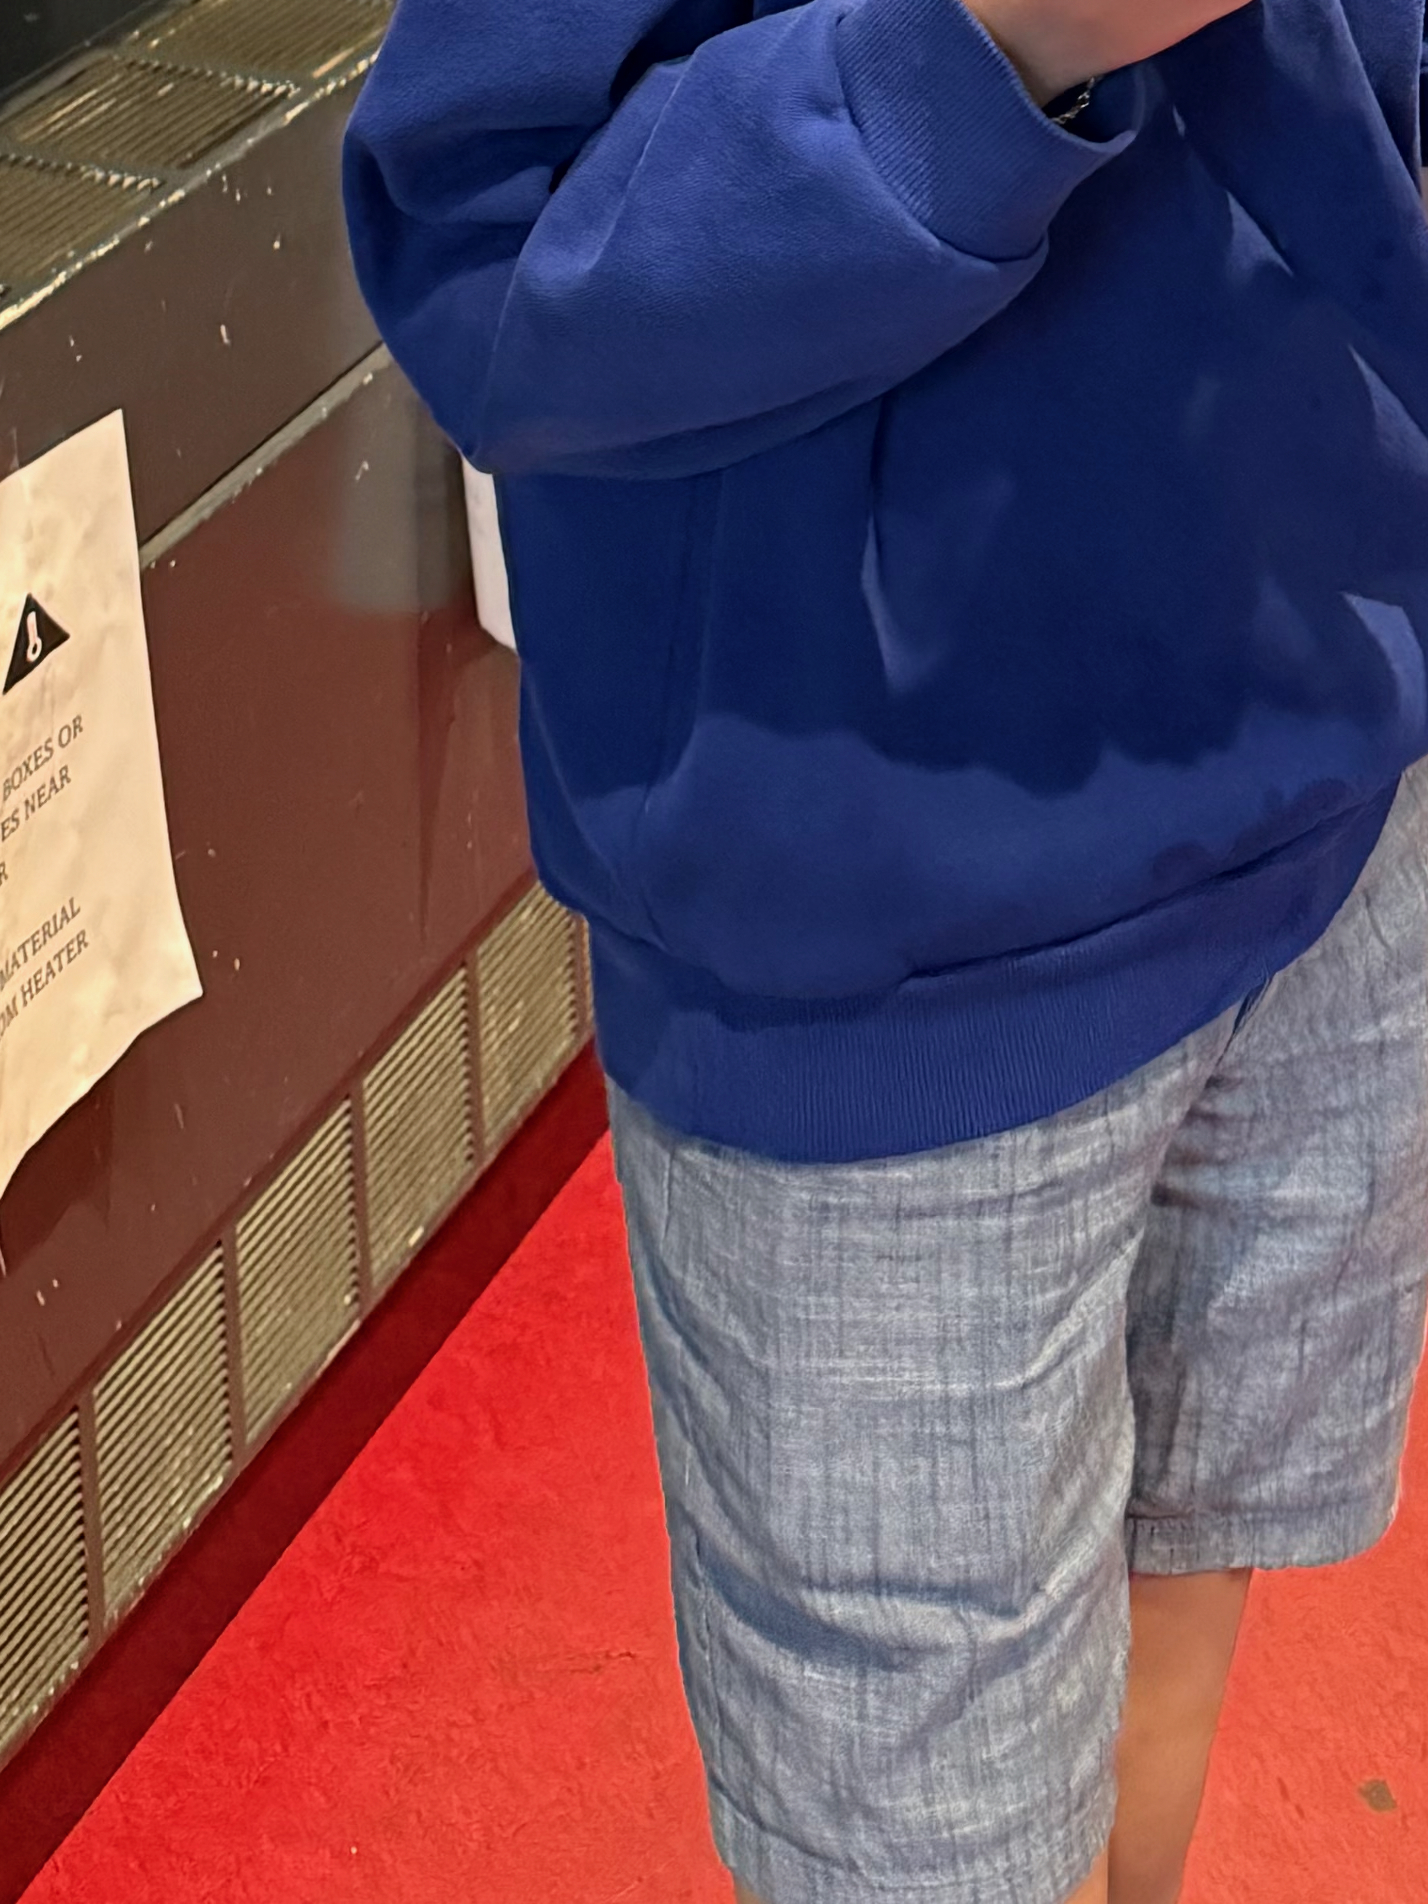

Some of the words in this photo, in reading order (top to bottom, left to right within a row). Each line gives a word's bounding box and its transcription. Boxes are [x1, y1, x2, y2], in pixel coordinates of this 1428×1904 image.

[1, 737, 54, 802] BOXES
[58, 714, 84, 750] OR
[24, 764, 71, 821] NEAR
[21, 928, 89, 1008] HEATER
